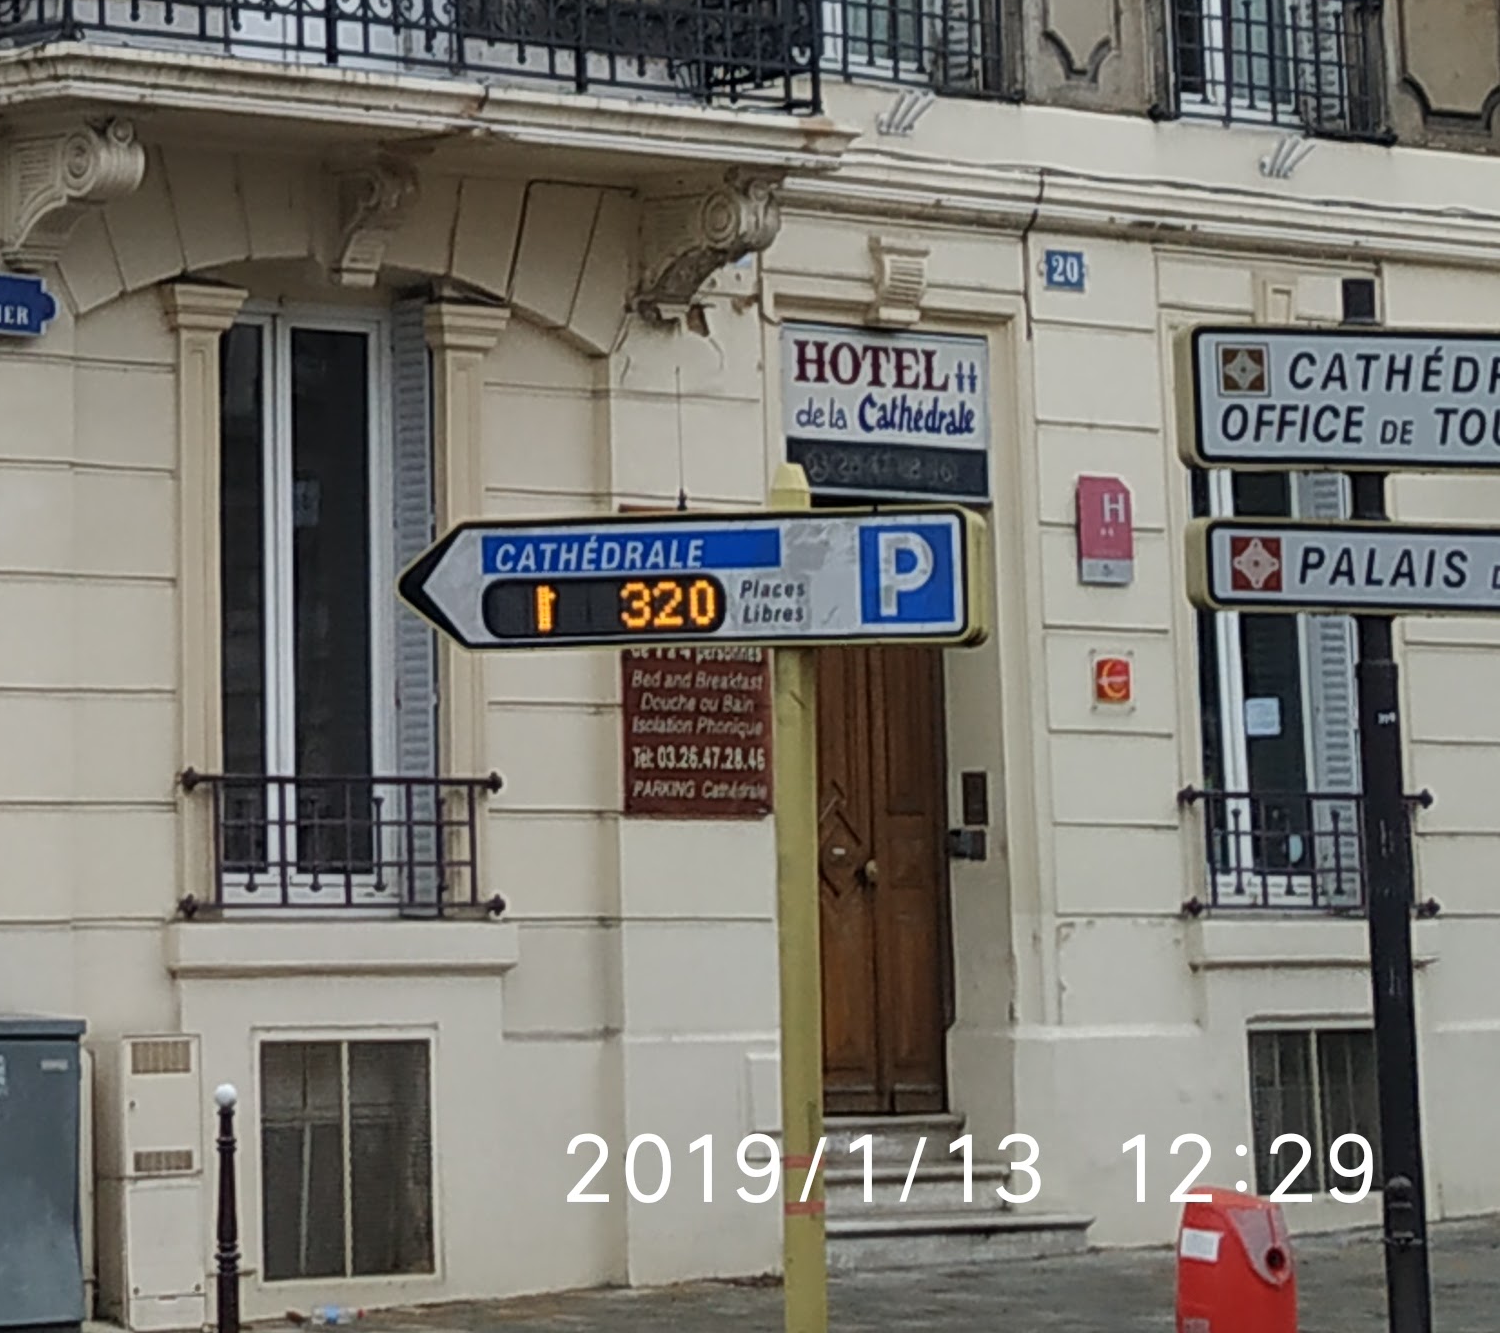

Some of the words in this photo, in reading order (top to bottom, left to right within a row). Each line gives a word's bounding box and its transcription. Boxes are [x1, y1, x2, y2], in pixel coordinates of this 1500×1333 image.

[1051, 254, 1080, 284] 20
[794, 339, 950, 392] HOTEL
[796, 397, 826, 429] de
[829, 398, 848, 431] la
[1220, 404, 1365, 444] OFFICE
[1380, 419, 1414, 446] DE
[1102, 492, 1125, 523] H
[495, 537, 705, 574] CATHÉDRALE
[1298, 545, 1469, 591] PALAIS
[619, 579, 716, 628] 320
[739, 579, 807, 601] Places
[742, 602, 806, 624] Libres
[631, 669, 662, 689] Bed
[664, 671, 692, 689] and
[640, 692, 697, 712] Douche
[700, 697, 719, 712] ou
[722, 694, 755, 713] Bain
[631, 715, 694, 733] Isolation
[696, 716, 764, 740] Phonique
[631, 779, 696, 799] PARKING
